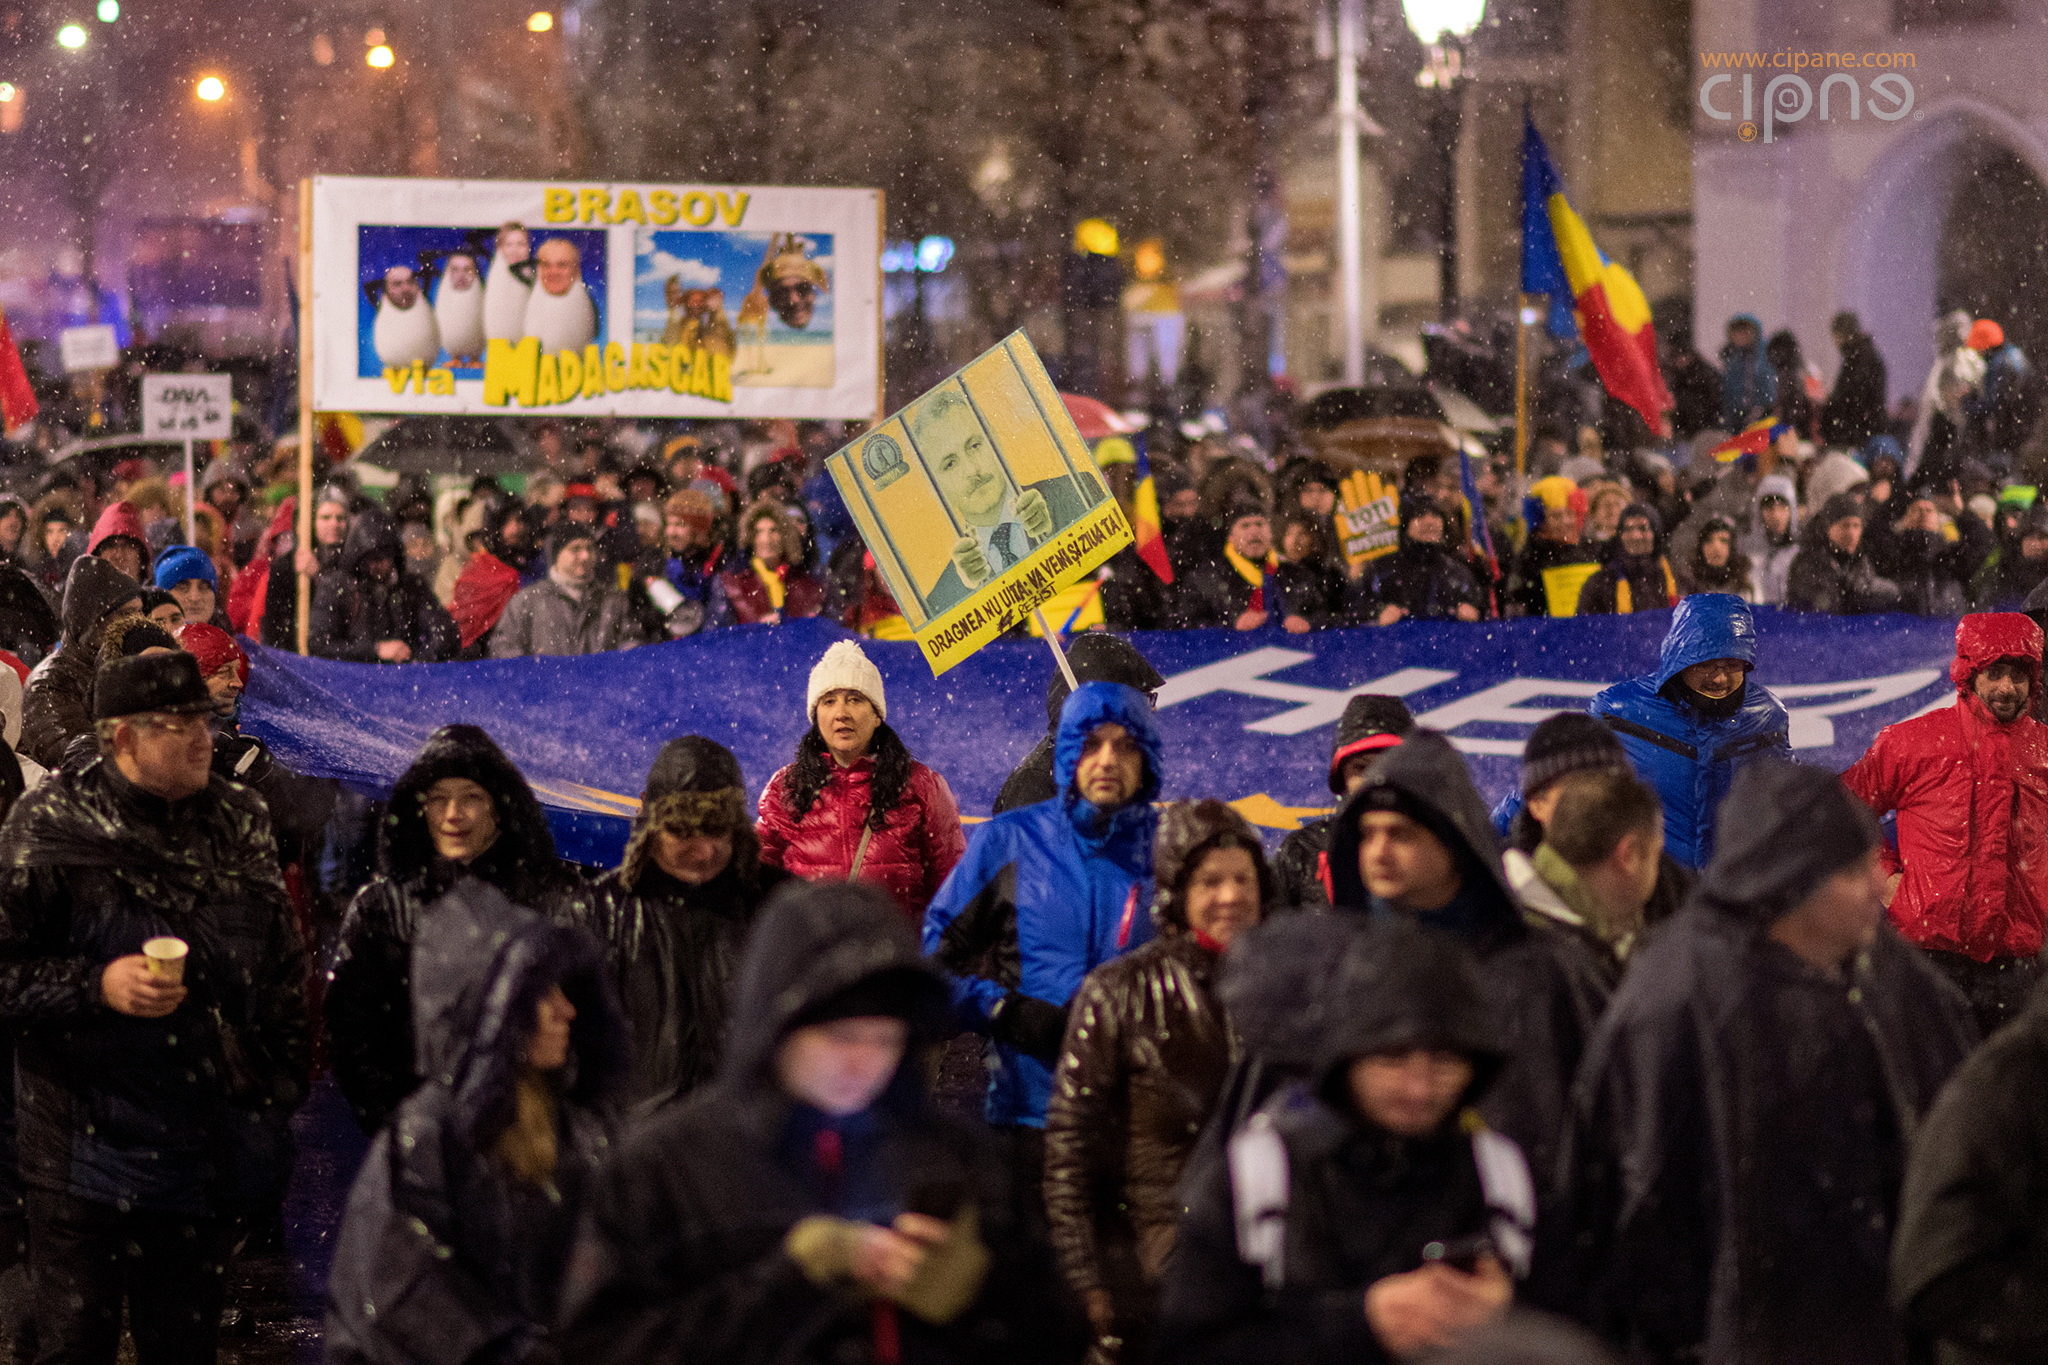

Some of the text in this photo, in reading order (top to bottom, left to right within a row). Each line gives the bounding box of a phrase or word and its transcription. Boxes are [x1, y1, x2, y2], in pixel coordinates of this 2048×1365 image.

[543, 187, 751, 227] BRASOV
[382, 336, 734, 407] via MADAGASCAR
[927, 608, 987, 658] DRAGNEA
[985, 596, 1004, 622] NU
